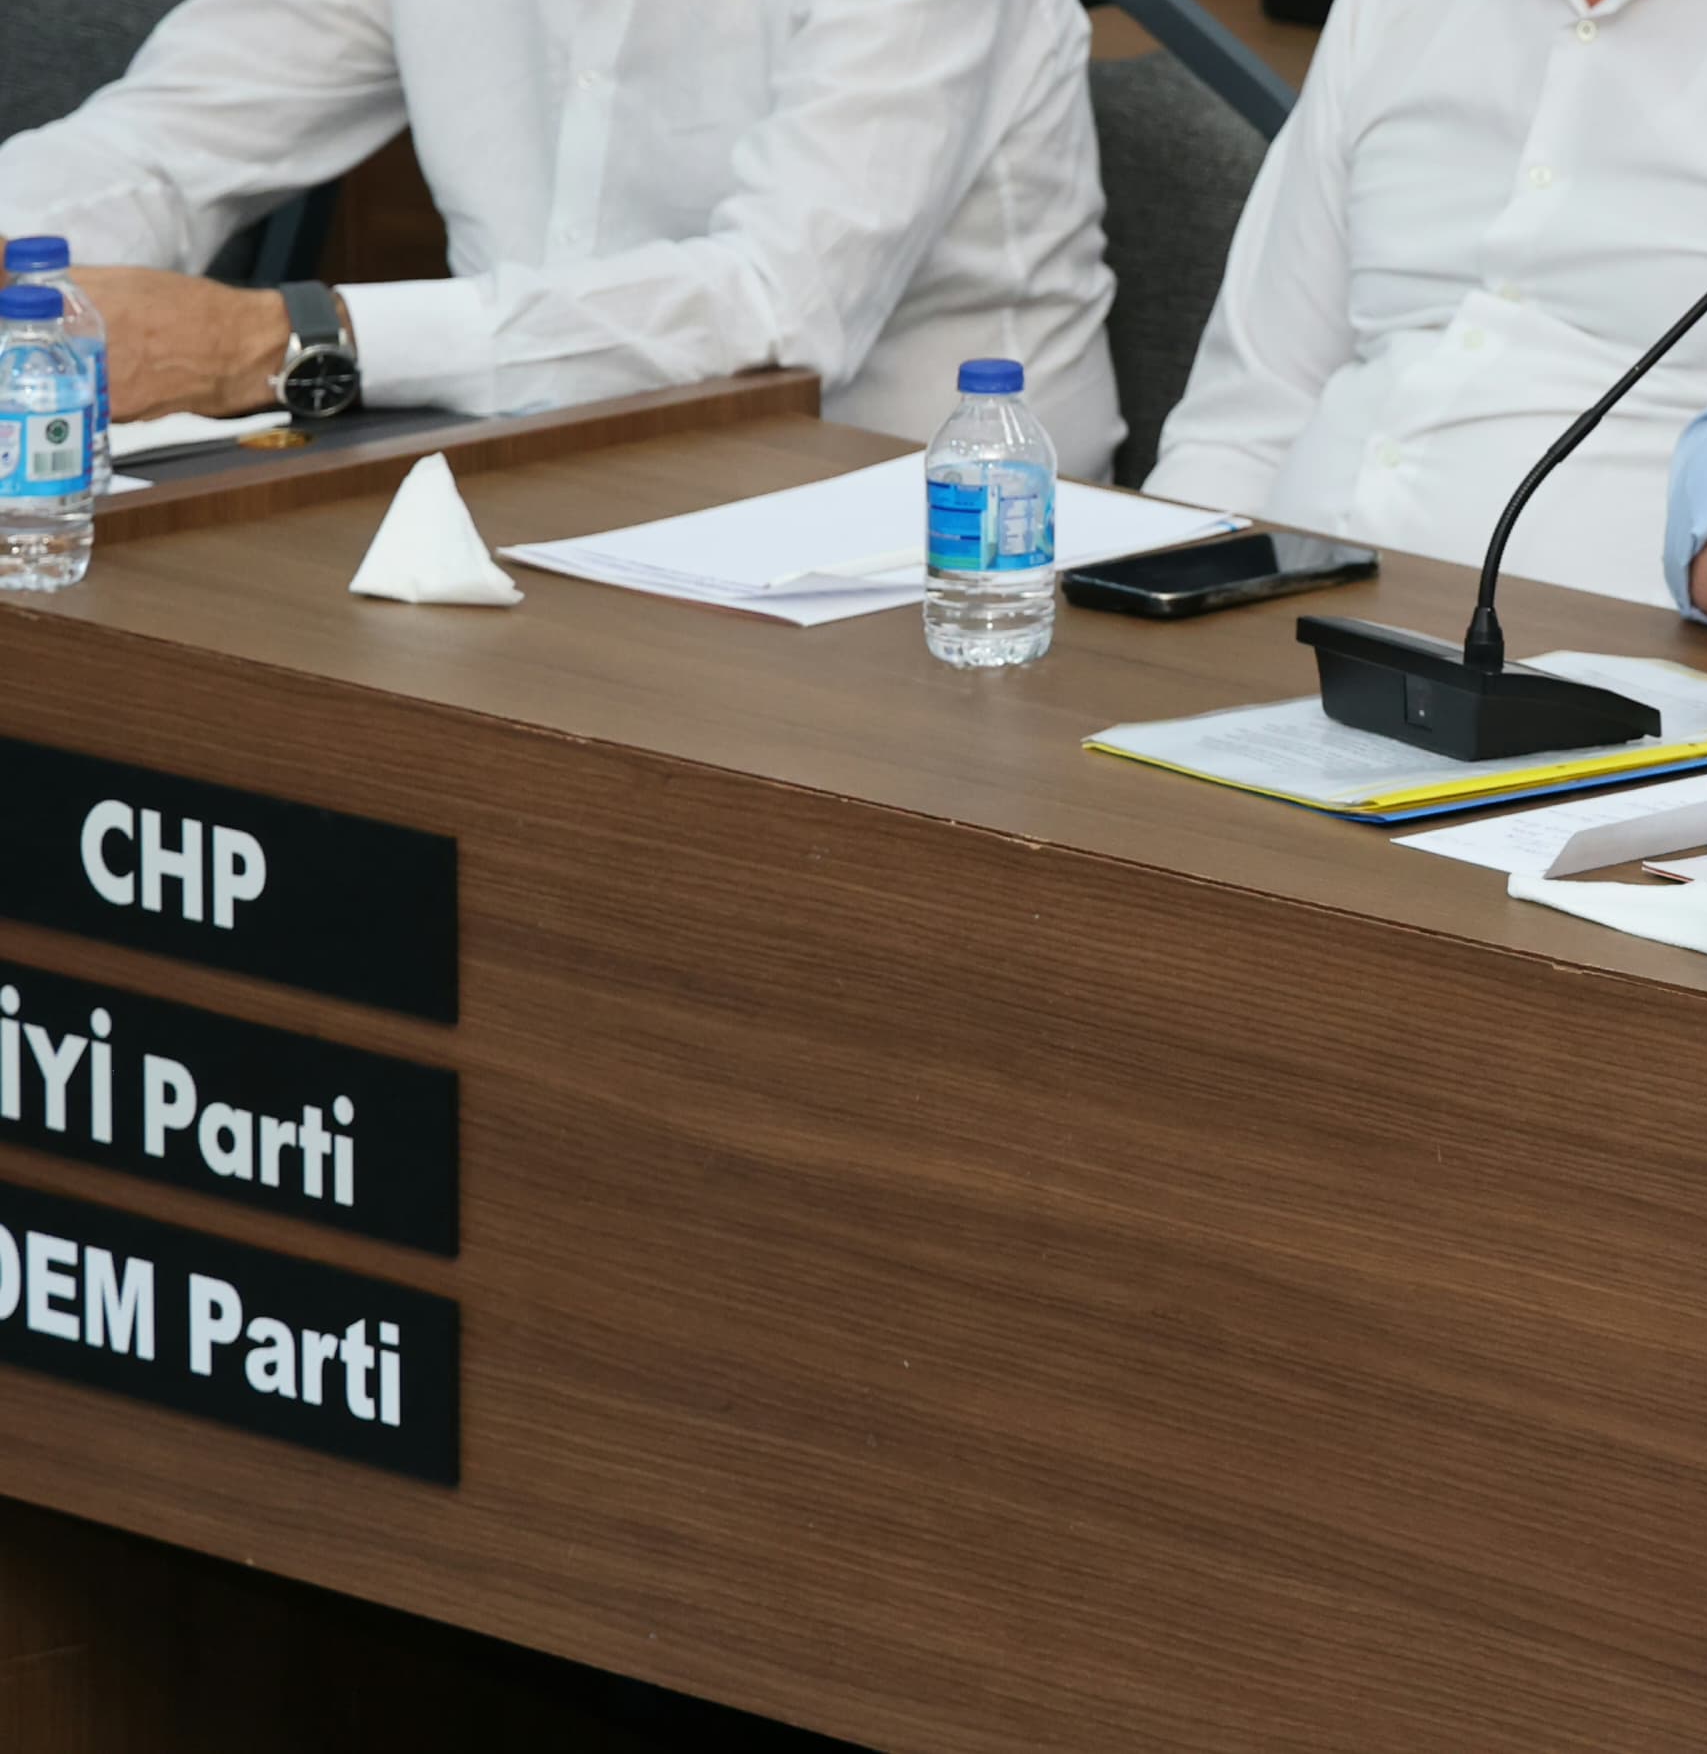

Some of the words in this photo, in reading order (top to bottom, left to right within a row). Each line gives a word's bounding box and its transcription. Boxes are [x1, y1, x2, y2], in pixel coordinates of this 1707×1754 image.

[81, 799, 267, 930] CHP
[0, 984, 112, 1144] İYİ
[144, 1053, 355, 1207] Parti
[189, 1272, 401, 1427] Parti
